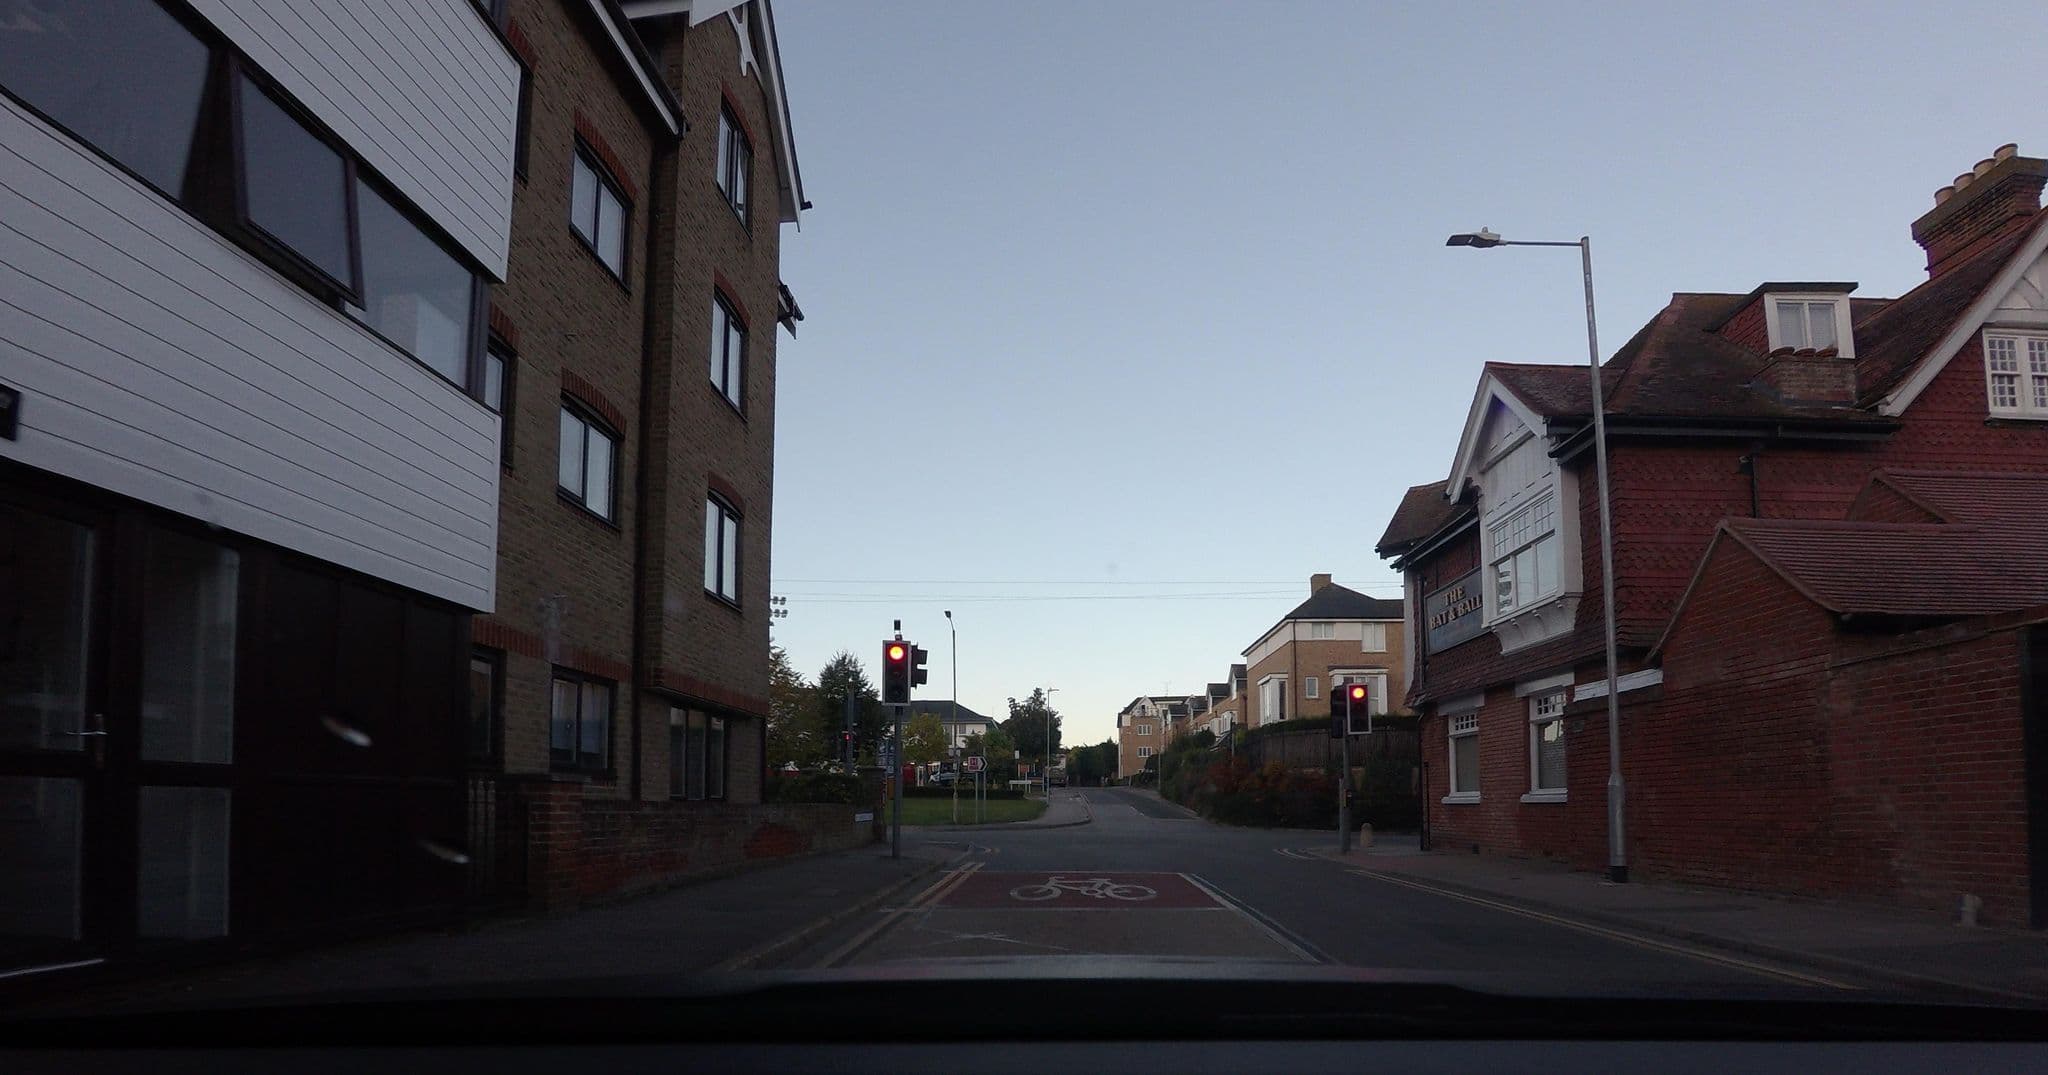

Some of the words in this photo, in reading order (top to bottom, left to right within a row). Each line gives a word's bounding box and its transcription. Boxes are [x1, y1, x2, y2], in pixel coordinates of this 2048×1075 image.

[1442, 585, 1465, 606] THE
[1430, 610, 1448, 629] BAT
[1457, 595, 1483, 617] BALL
